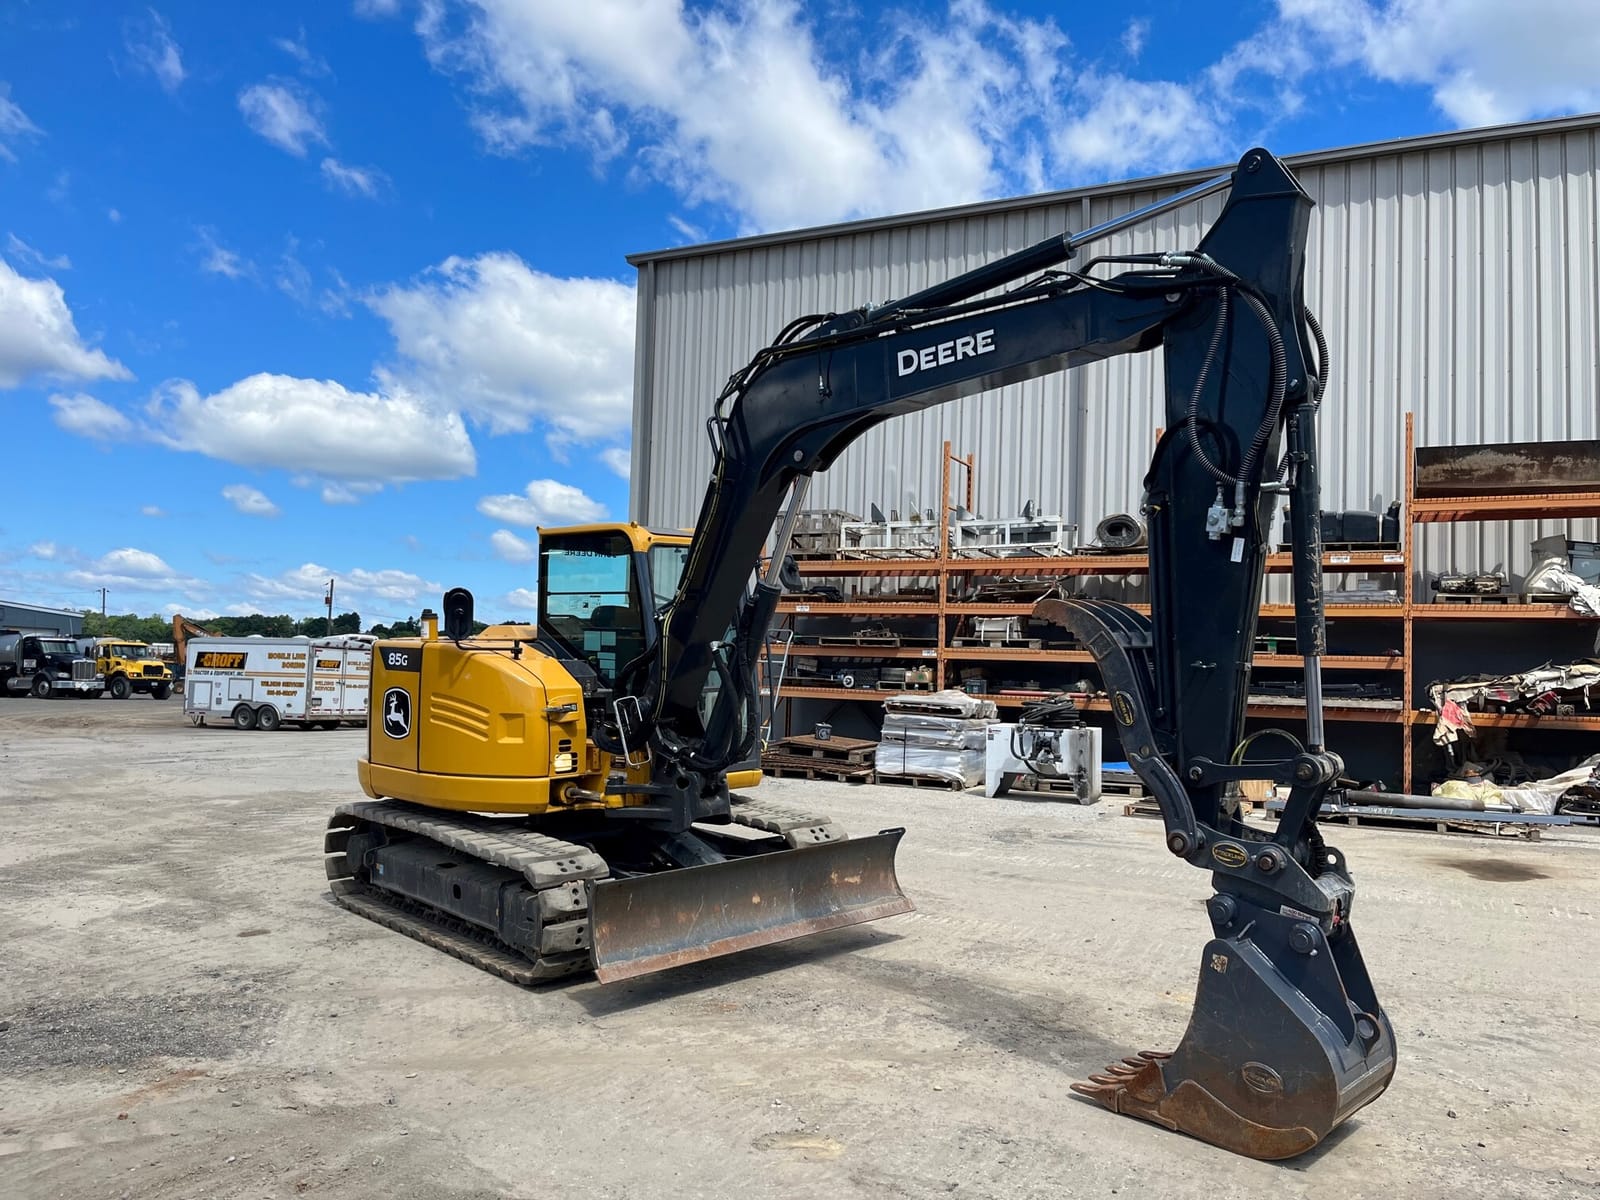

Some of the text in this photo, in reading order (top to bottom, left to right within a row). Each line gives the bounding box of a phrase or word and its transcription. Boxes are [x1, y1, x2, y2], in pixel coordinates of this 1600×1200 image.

[897, 328, 995, 376] DEERE
[201, 653, 243, 667] GROFF
[388, 652, 409, 666] 85G
